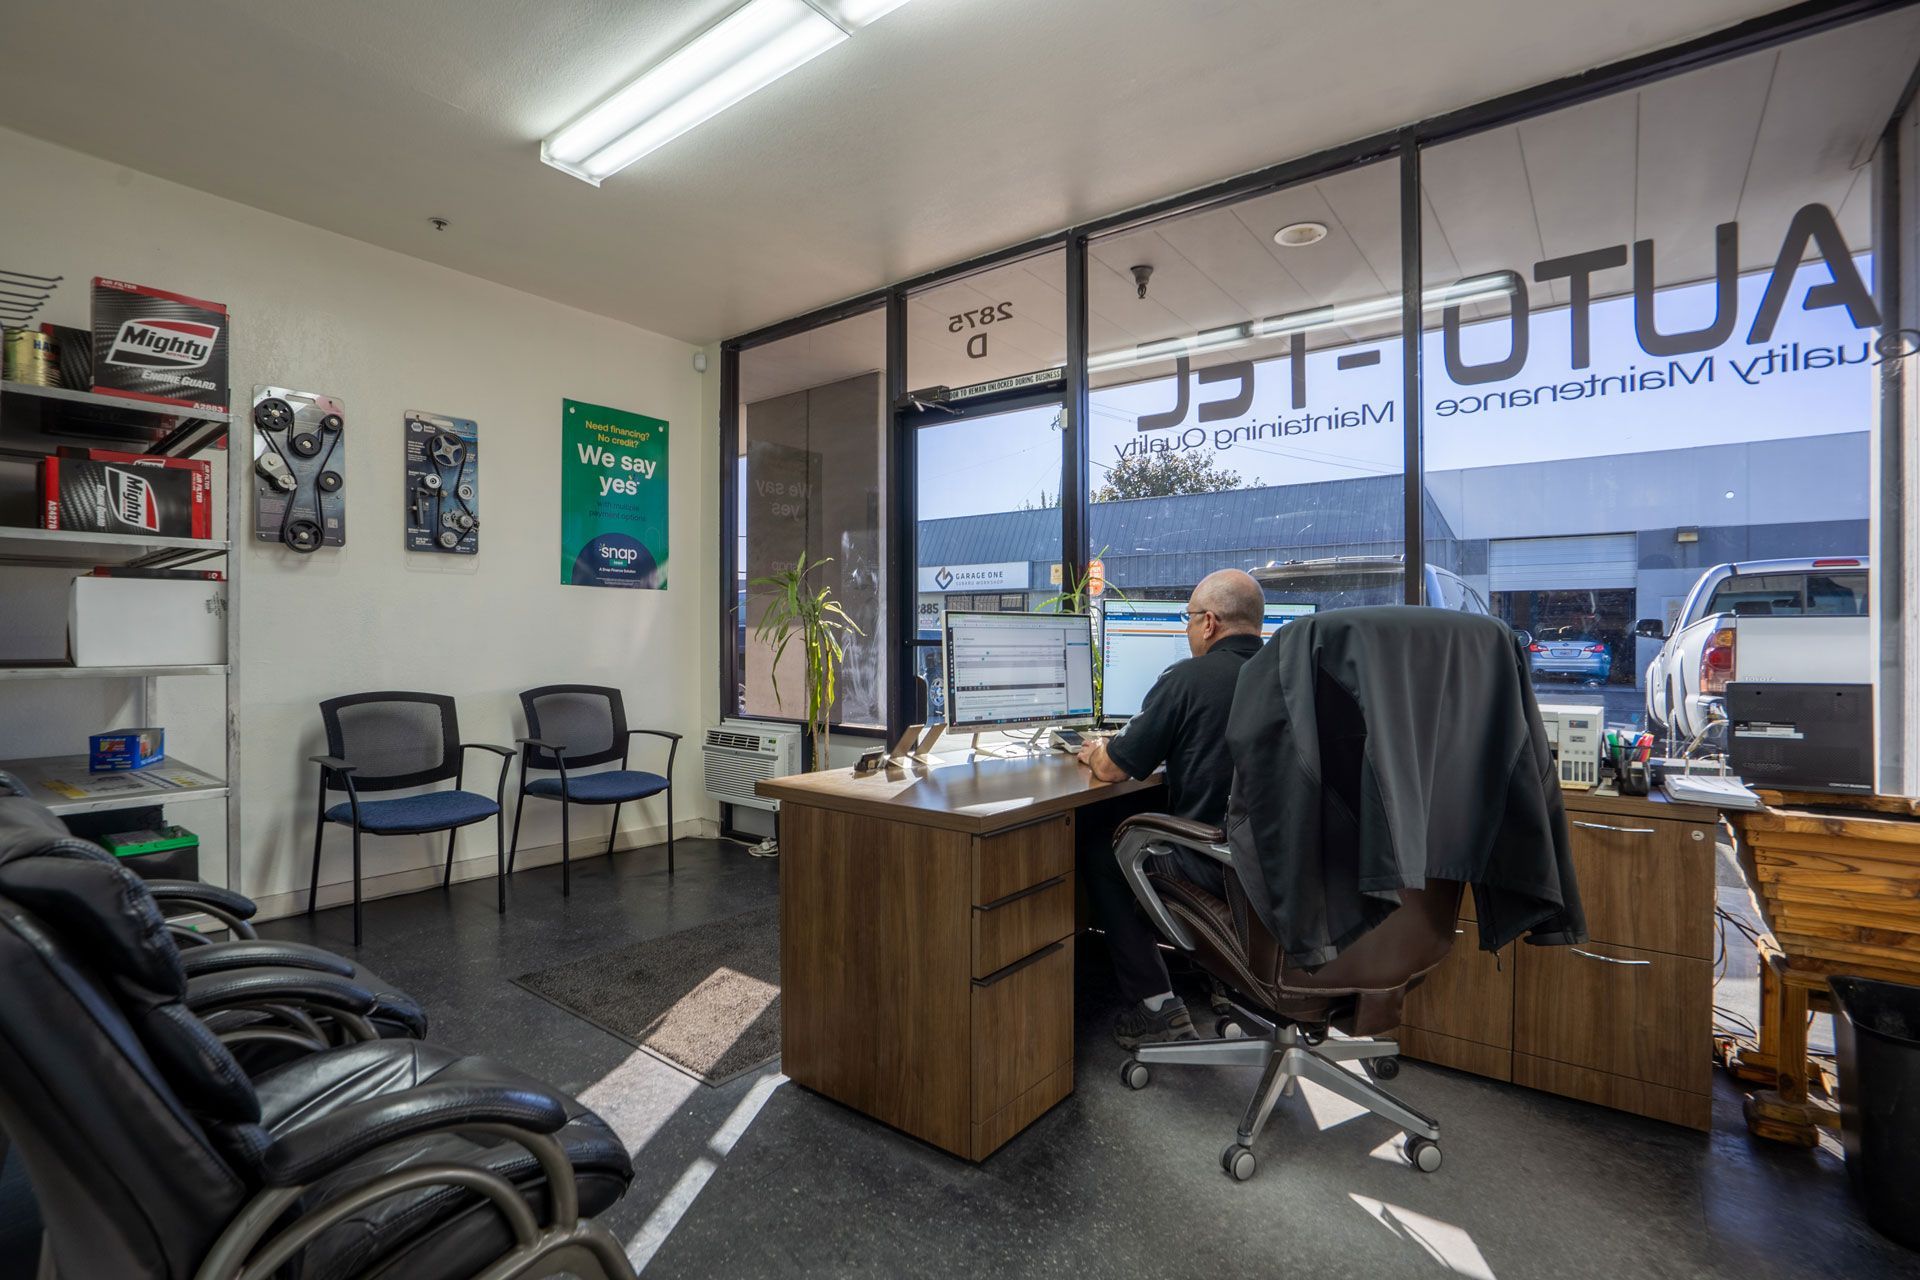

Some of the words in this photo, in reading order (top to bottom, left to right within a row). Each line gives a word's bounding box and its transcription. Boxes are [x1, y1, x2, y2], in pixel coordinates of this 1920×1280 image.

[121, 325, 208, 360] Mighty
[142, 369, 181, 385] ENGINE
[969, 386, 987, 395] REMAIN
[988, 379, 1014, 391] UNLOCKED
[1015, 375, 1034, 386] DURING
[1035, 369, 1060, 382] BUSINESS
[585, 420, 609, 432] Need
[610, 425, 650, 441] financing?
[597, 433, 610, 443] No
[612, 437, 639, 448] credit?
[577, 442, 615, 468] We
[620, 455, 656, 479] say
[123, 475, 144, 525] Mighty
[601, 546, 638, 564] snap
